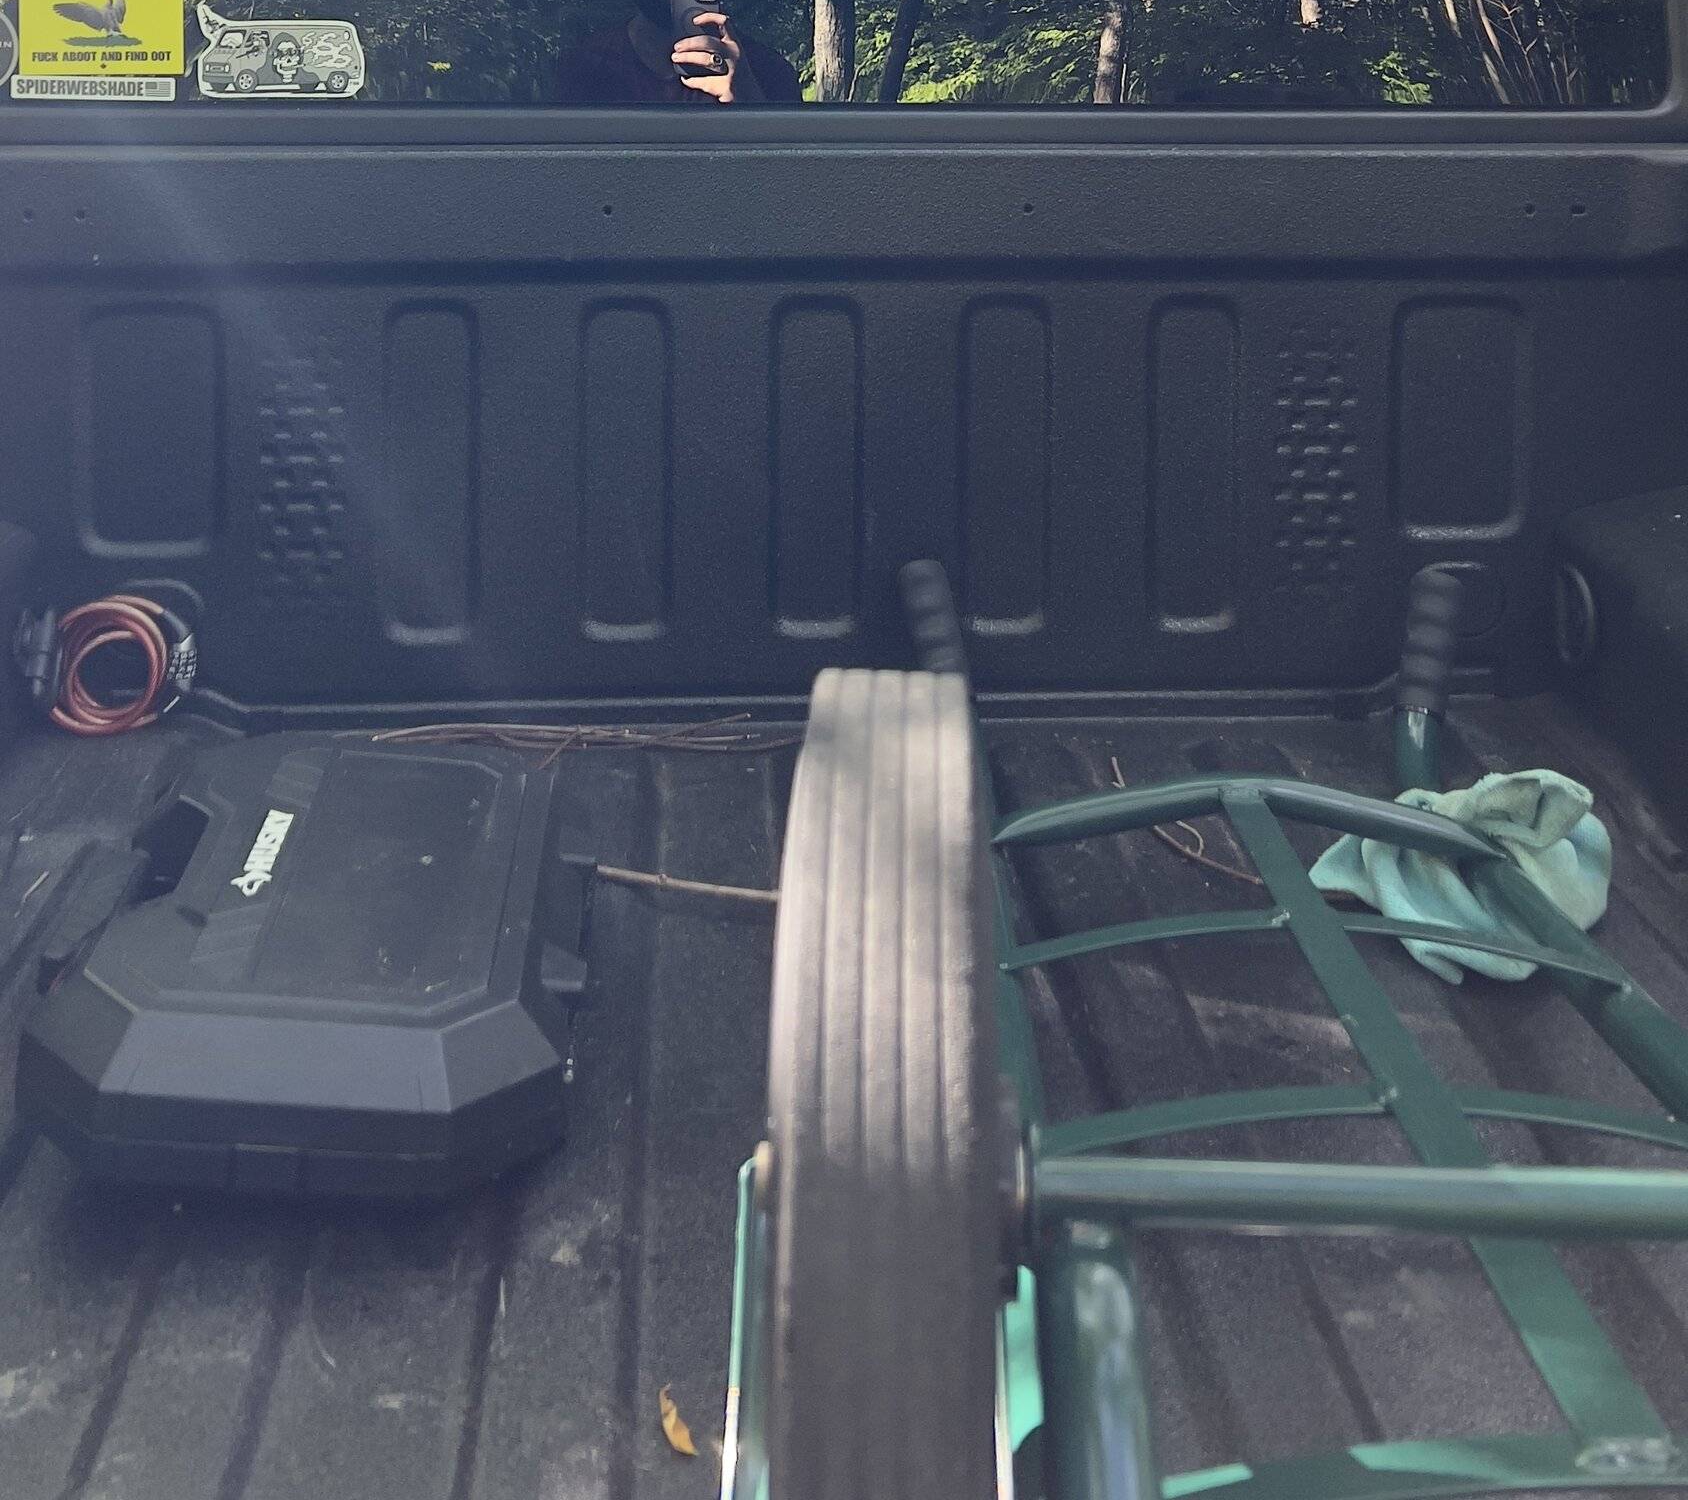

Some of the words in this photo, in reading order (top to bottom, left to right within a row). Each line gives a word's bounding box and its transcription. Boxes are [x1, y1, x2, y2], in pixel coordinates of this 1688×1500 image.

[32, 52, 59, 62] FUCK
[62, 52, 97, 61] ABOOT
[101, 52, 122, 61] AND
[125, 51, 148, 61] FIND
[151, 51, 172, 61] OOT
[16, 79, 144, 97] SPIDERWEBSHADE
